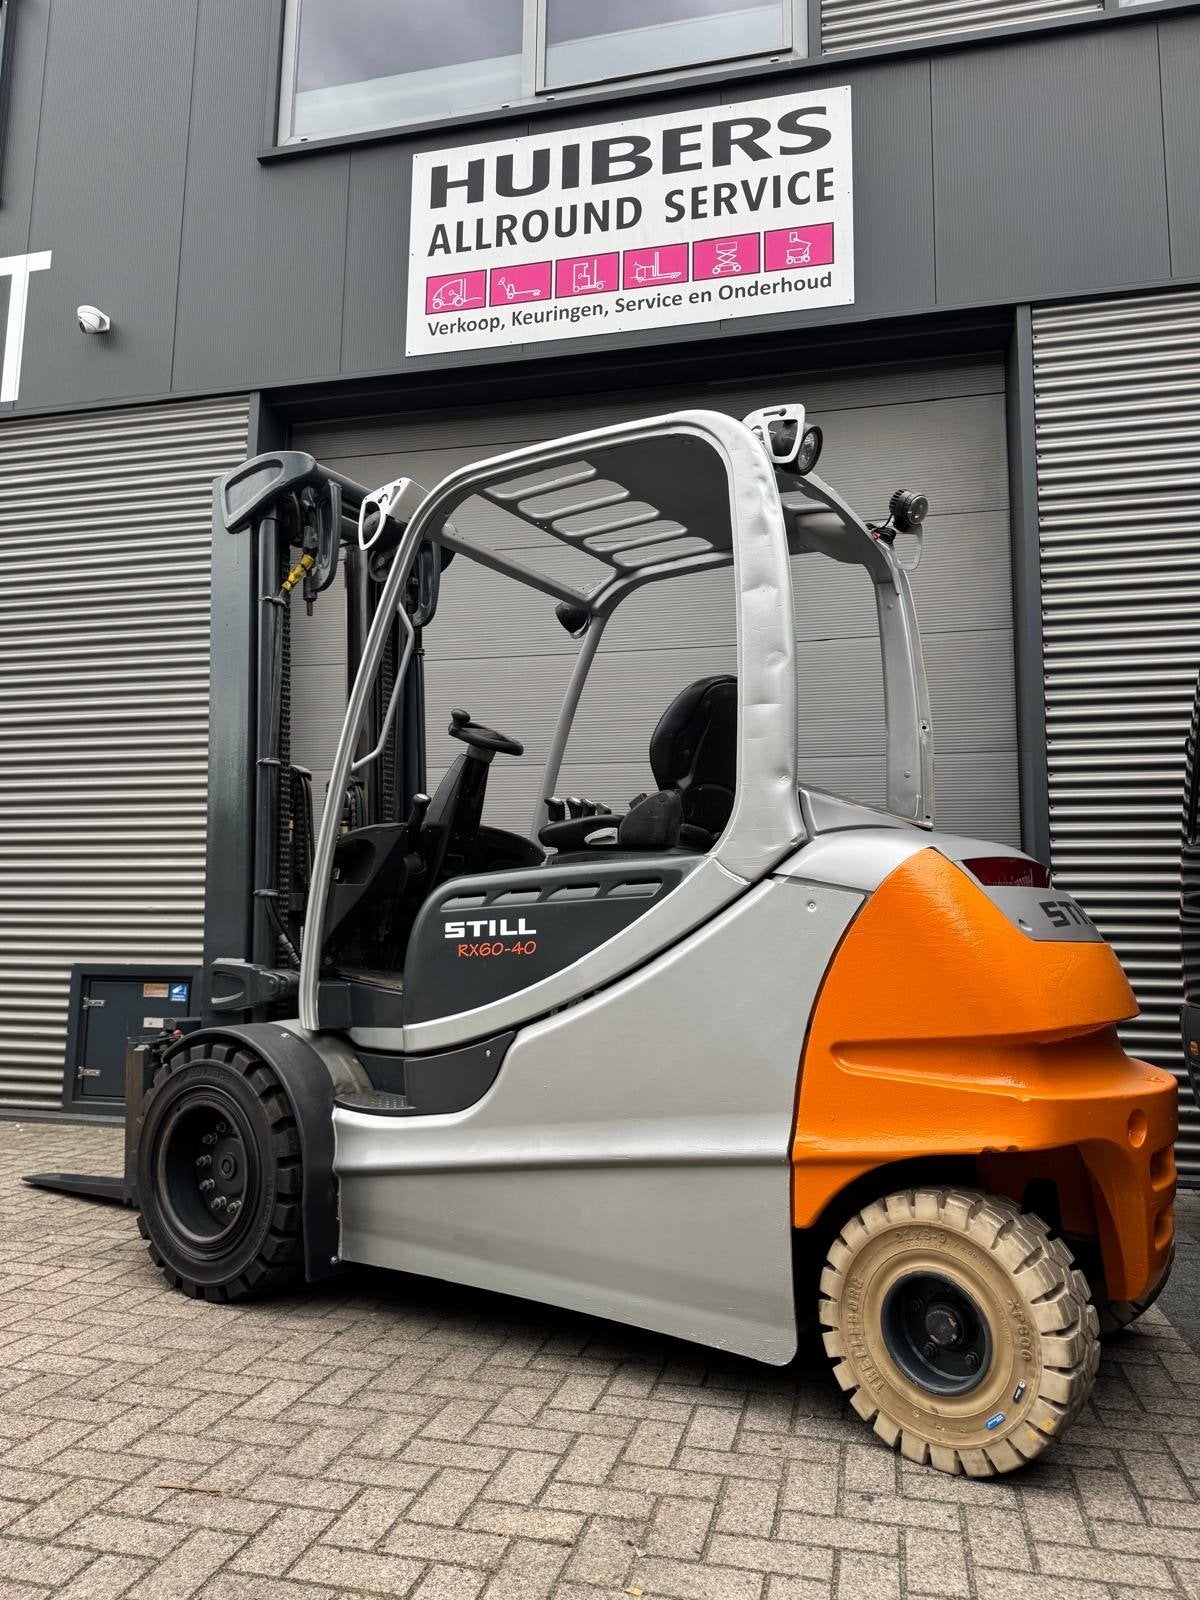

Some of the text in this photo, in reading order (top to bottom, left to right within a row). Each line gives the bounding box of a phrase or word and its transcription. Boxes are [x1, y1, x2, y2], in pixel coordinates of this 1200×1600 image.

[429, 106, 832, 209] HUIBERS
[427, 167, 835, 257] ALLROUND SERVICE
[427, 272, 832, 336] Verkoop, Keuringen, Service en Onderhoud
[444, 918, 537, 939] STILL
[457, 940, 537, 958] RX60-40
